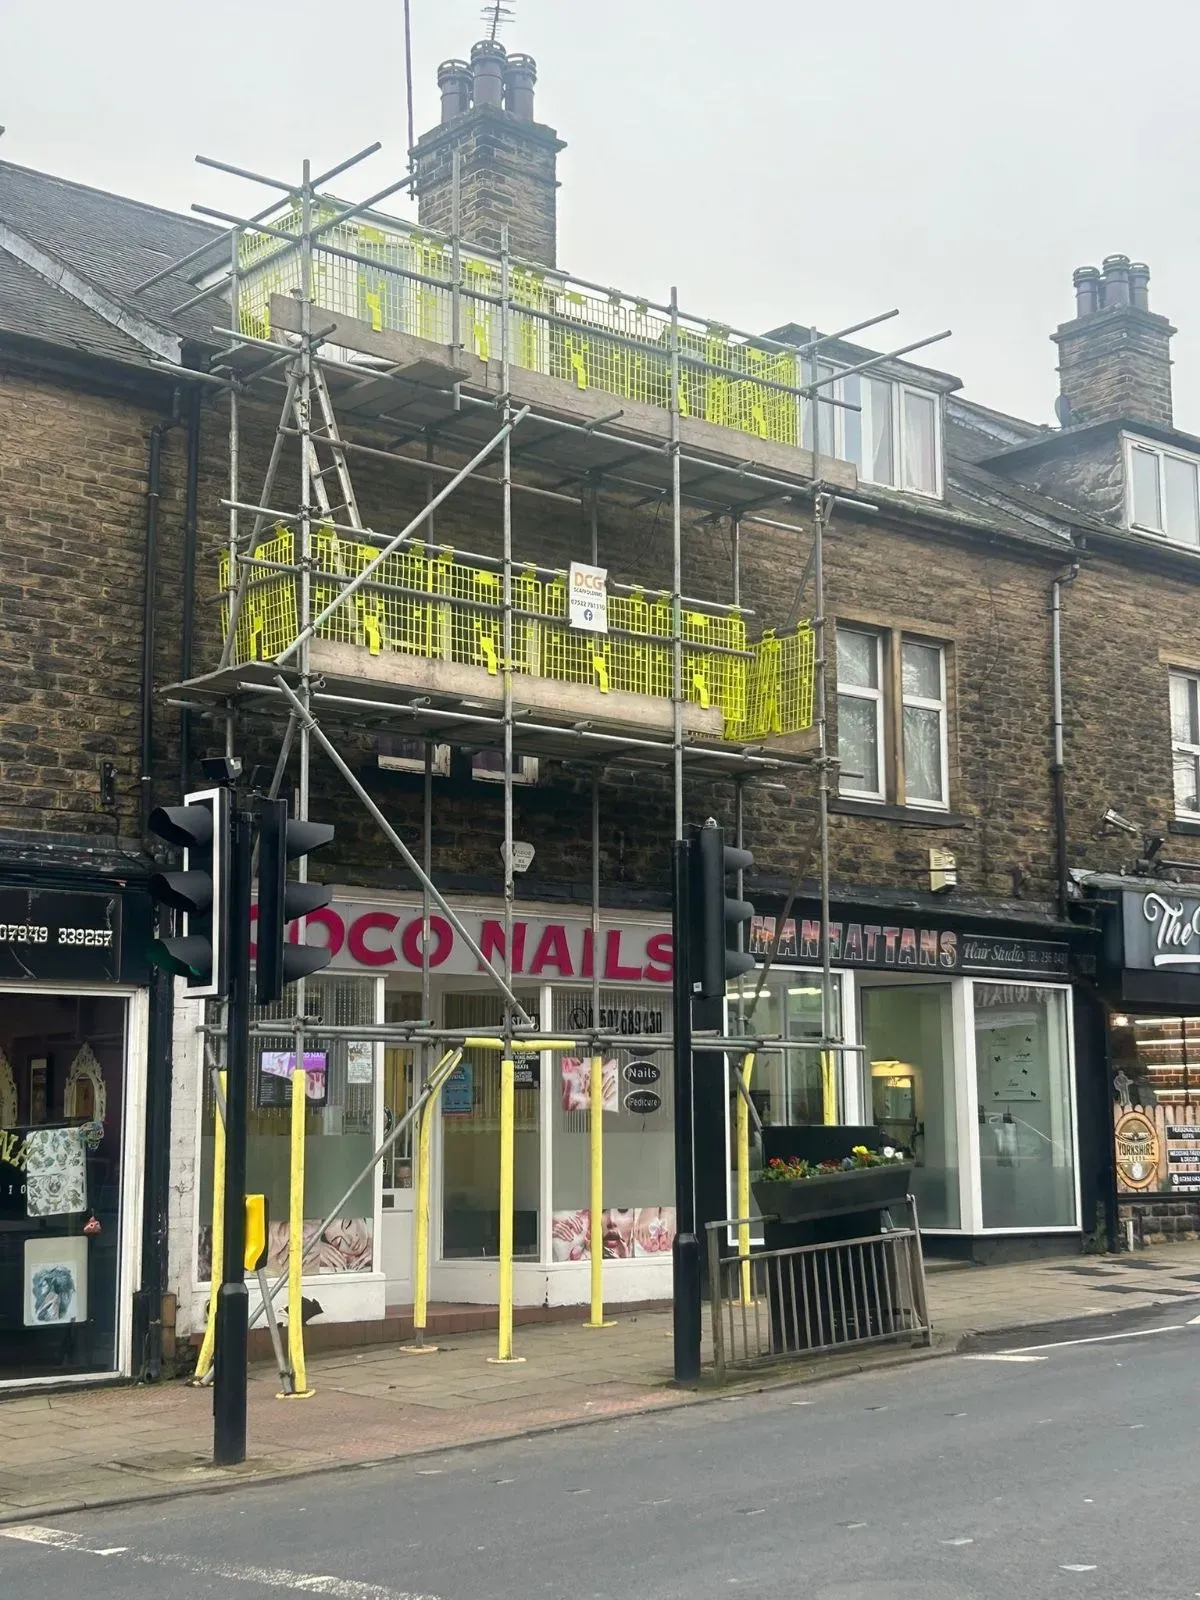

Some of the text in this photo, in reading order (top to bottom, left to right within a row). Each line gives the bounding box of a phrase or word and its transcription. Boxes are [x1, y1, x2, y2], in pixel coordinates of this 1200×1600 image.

[574, 571, 602, 590] DCG
[1143, 892, 1193, 950] The
[58, 927, 113, 946] 339257
[749, 915, 957, 967] MANHATTANS
[478, 919, 674, 982] NAILS
[963, 941, 991, 960] Hair
[991, 943, 1024, 962] Studio
[629, 1067, 657, 1078] Nails
[629, 1097, 658, 1107] Pedicure
[1118, 1141, 1155, 1156] YORKSHIRE
